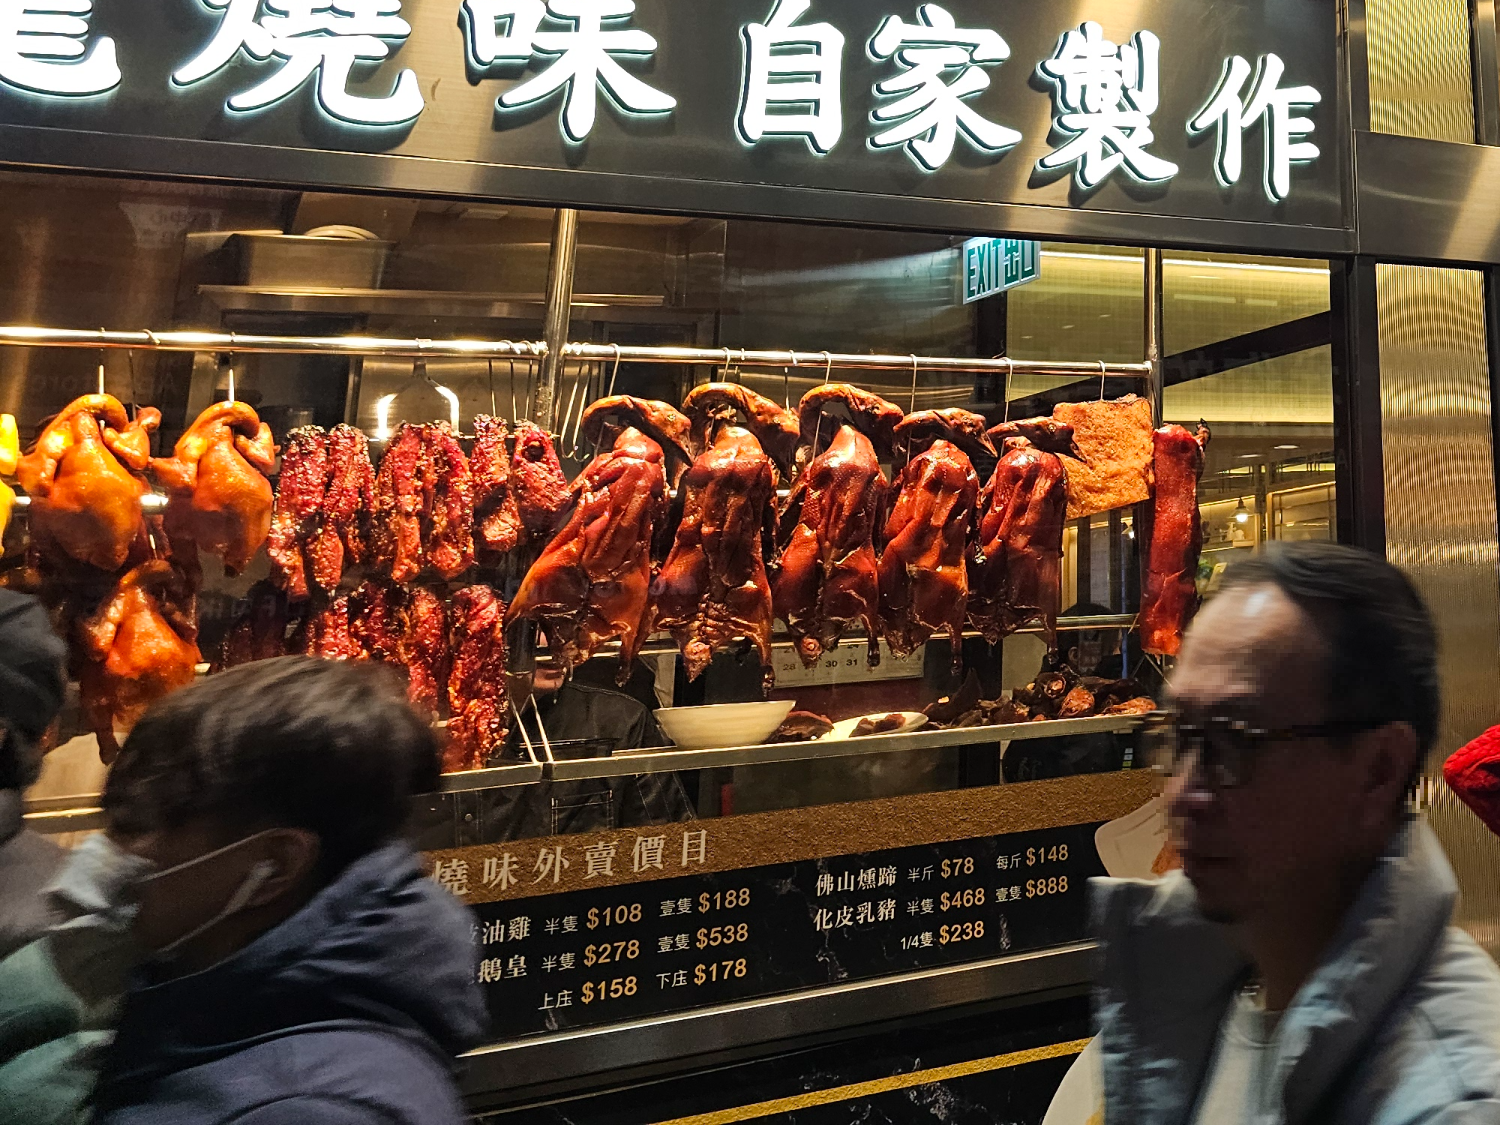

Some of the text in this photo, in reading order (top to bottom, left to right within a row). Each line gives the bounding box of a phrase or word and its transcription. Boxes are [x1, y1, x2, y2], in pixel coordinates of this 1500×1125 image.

[967, 239, 1036, 299] EXIT 出口
[825, 660, 838, 668] 30
[846, 658, 858, 667] 31
[434, 828, 708, 897] 燒味外賣價目
[907, 864, 935, 883] 半斤
[940, 856, 975, 880] $78
[996, 843, 1069, 871] 每斤 $148
[543, 915, 579, 935] 半隻
[586, 902, 643, 931] $108
[658, 896, 693, 918] 壹隻
[698, 886, 751, 914] $188
[813, 875, 1069, 932] 化皮乳豬 半隻 $468 壹隻 $888
[469, 923, 749, 986] 鵝皇 半隻 $278 壹隻 $538
[900, 920, 985, 951] 1/4隻 $238
[580, 975, 638, 1005] $158
[693, 957, 748, 986] $178
